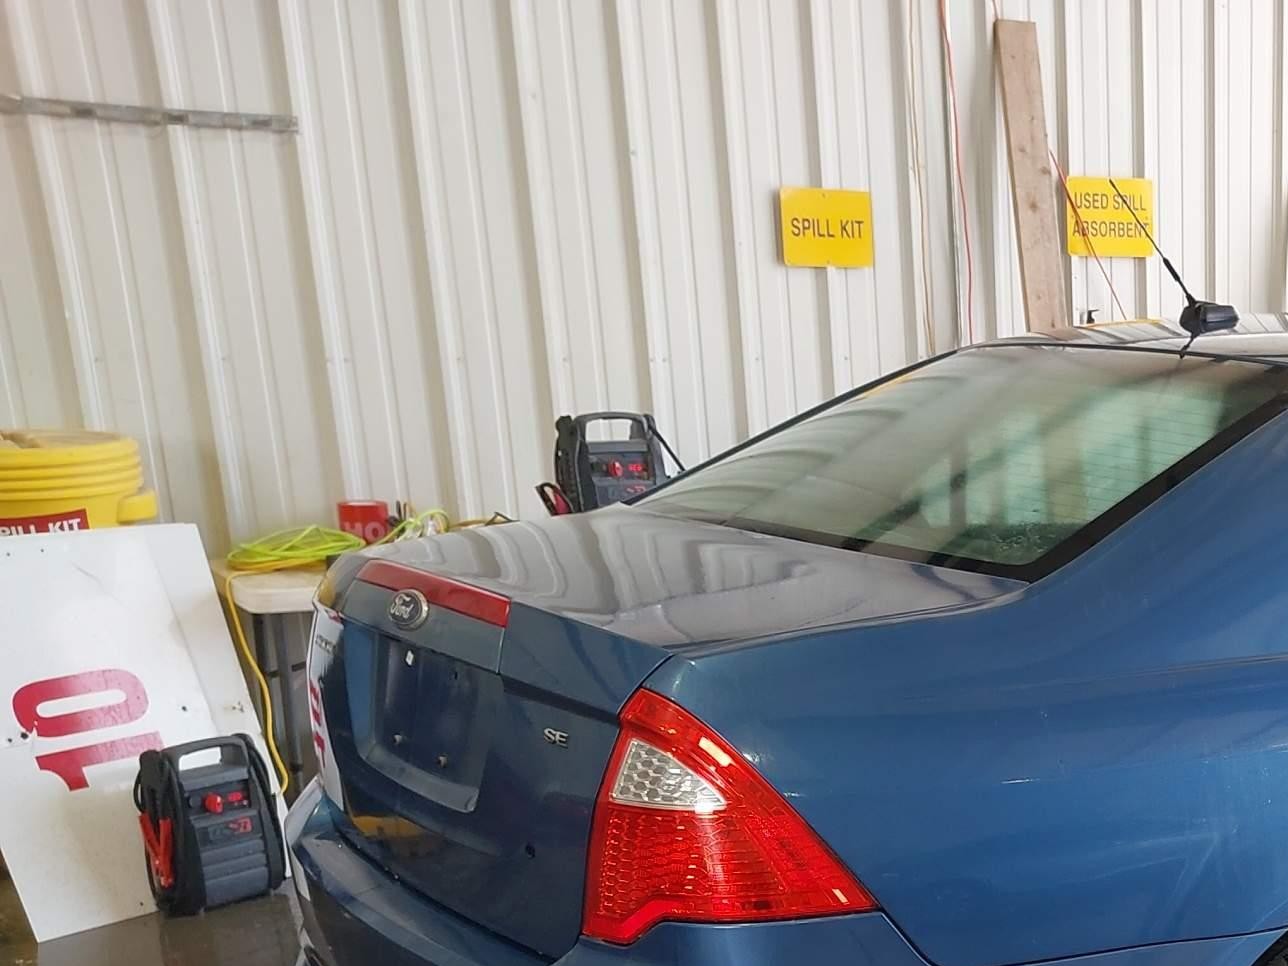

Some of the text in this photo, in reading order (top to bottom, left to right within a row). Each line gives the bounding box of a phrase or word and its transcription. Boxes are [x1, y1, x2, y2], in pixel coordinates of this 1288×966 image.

[1074, 192, 1147, 211] USED SPILL
[791, 217, 865, 239] SPILL KIT
[1072, 221, 1150, 239] ABSORBENT
[48, 518, 81, 534] KIT
[390, 592, 415, 619] Ford
[543, 727, 569, 749] SE
